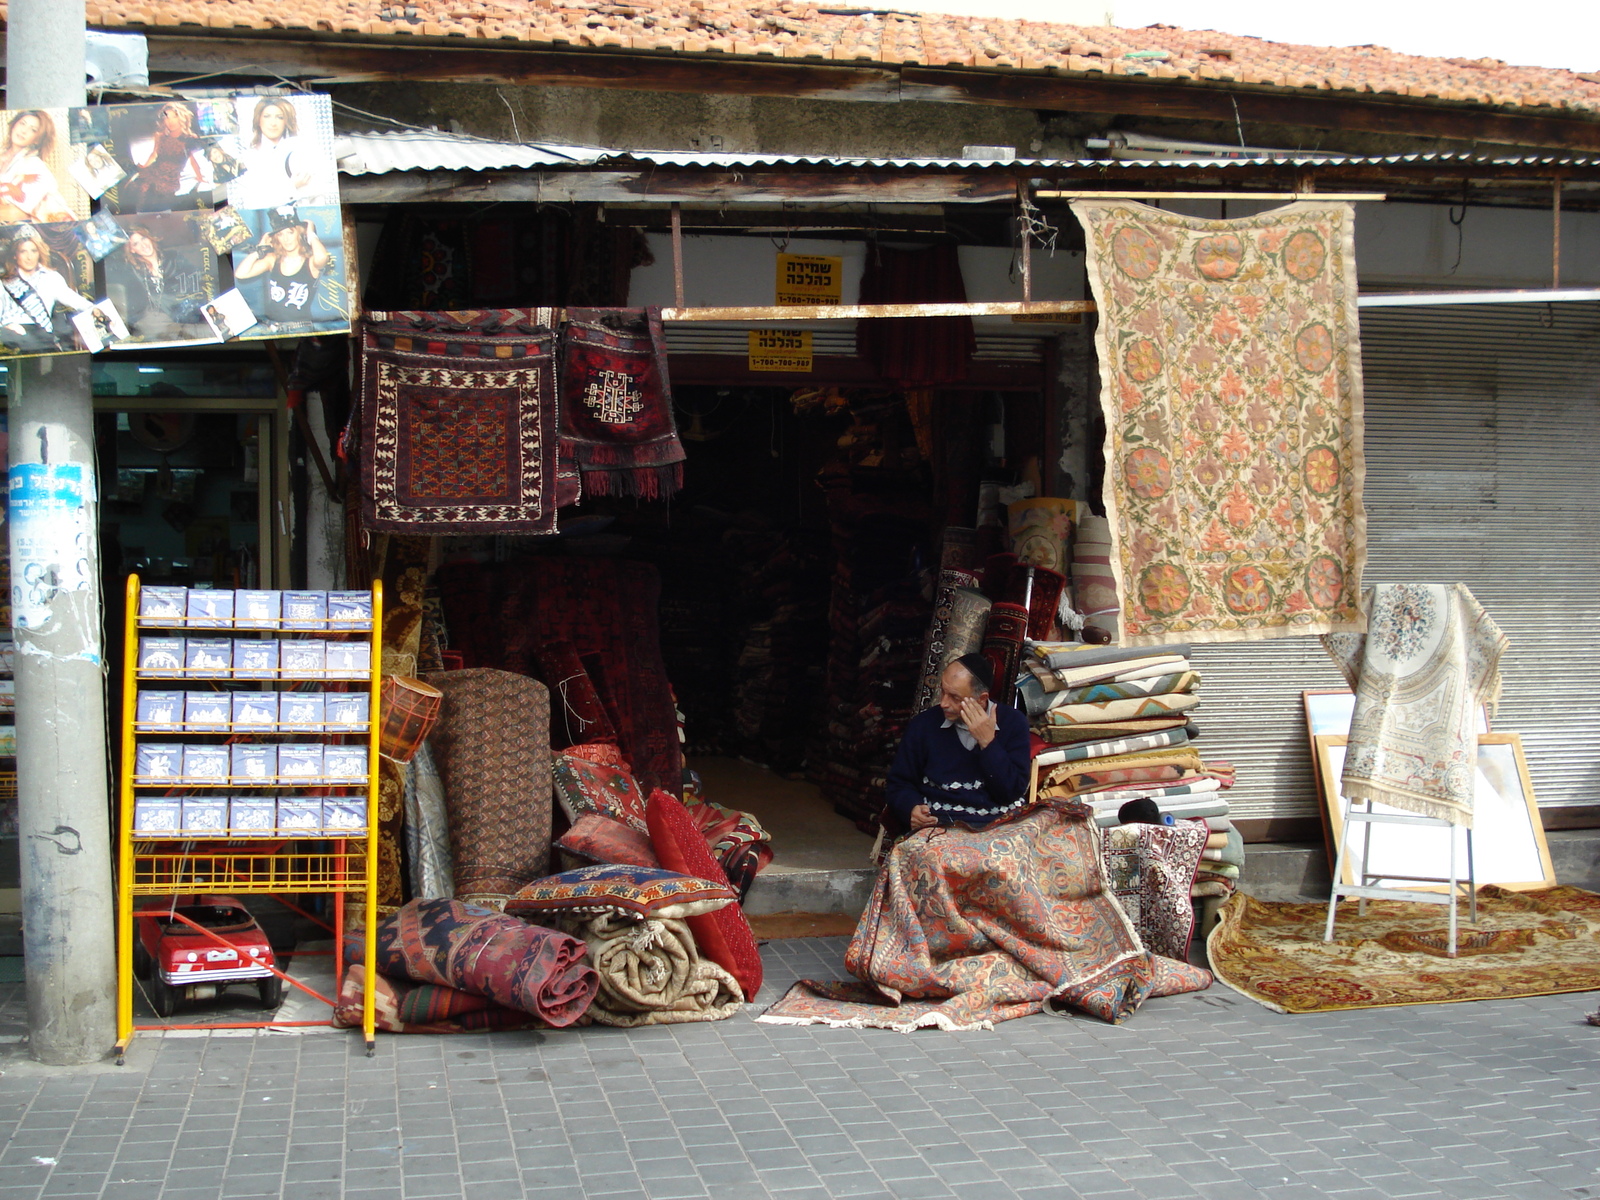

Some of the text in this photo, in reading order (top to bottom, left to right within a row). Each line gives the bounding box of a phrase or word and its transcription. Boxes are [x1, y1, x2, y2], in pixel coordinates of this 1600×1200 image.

[787, 261, 832, 274] שמירה
[786, 273, 832, 286] כהלכה
[318, 278, 349, 321] July
[759, 337, 803, 349] כהלכה
